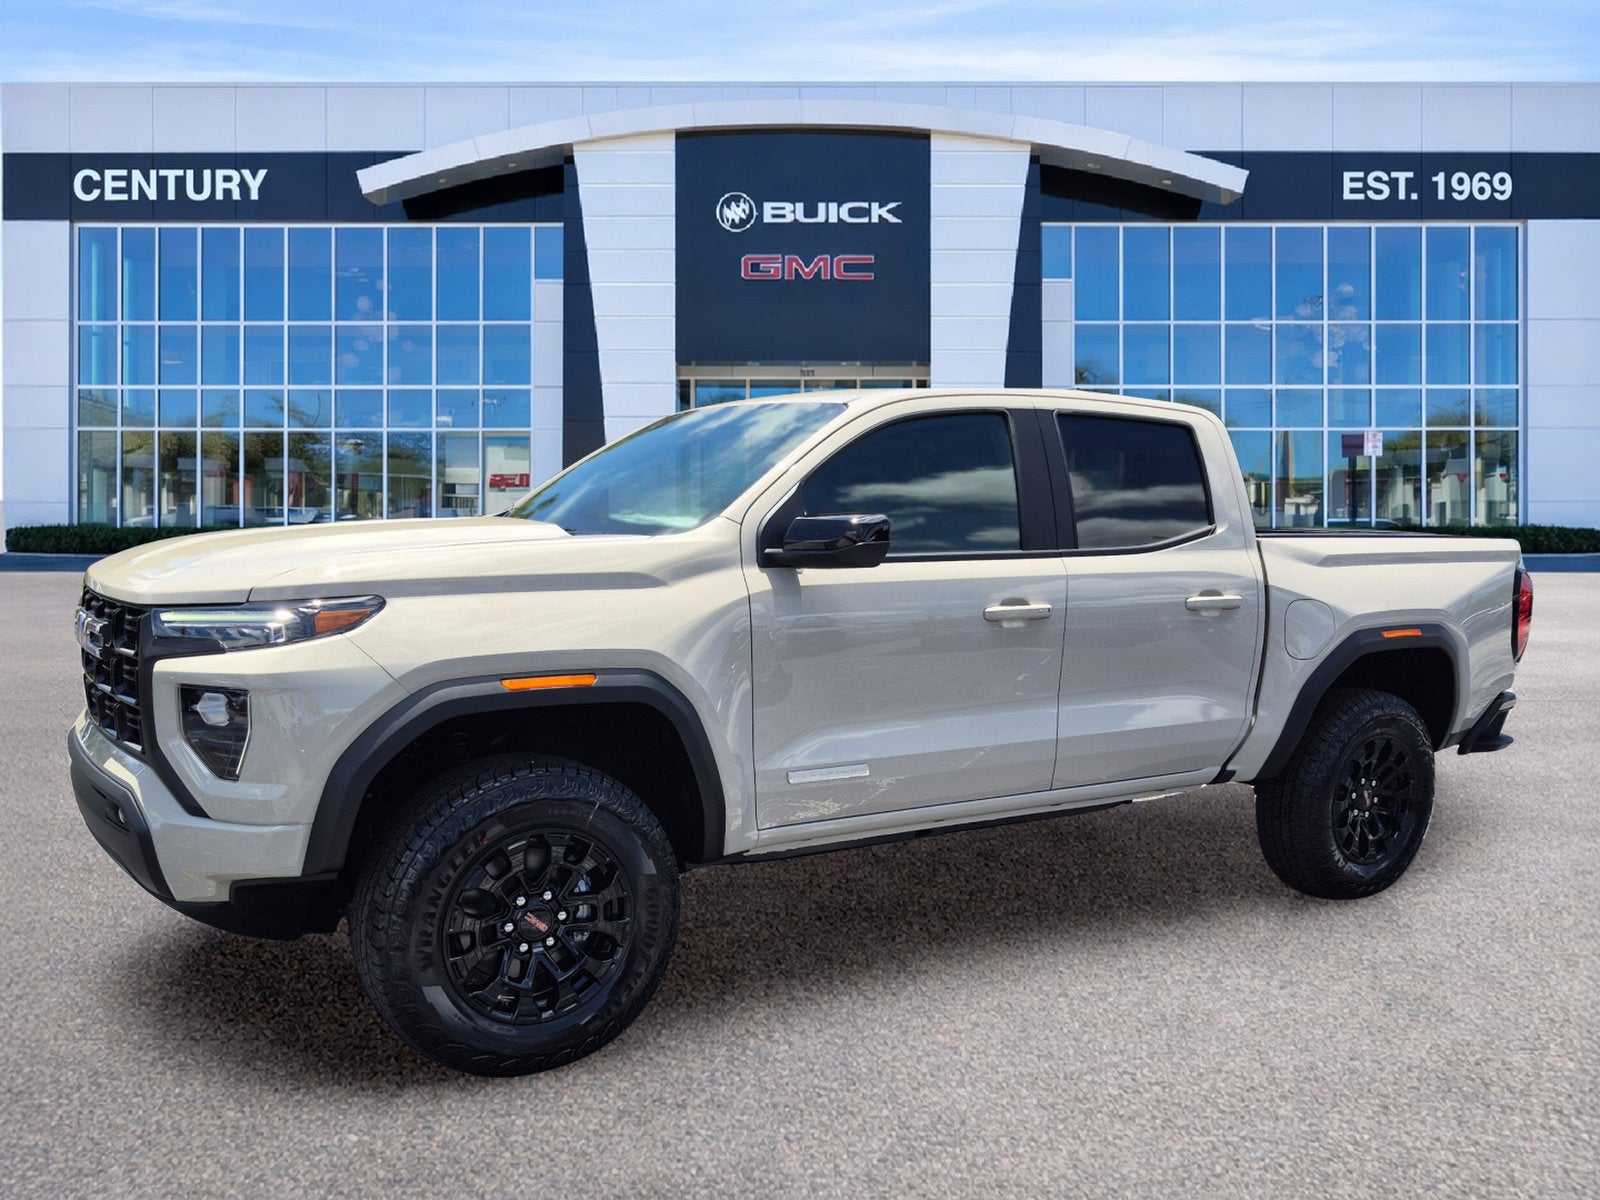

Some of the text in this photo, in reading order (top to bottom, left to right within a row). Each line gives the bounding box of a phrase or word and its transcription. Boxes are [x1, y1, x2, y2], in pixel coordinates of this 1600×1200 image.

[73, 169, 268, 201] CENTURY
[1342, 171, 1512, 200] EST. 1969
[763, 202, 902, 223] BUICK
[741, 255, 874, 280] GMC
[416, 829, 488, 971] WRANGLER
